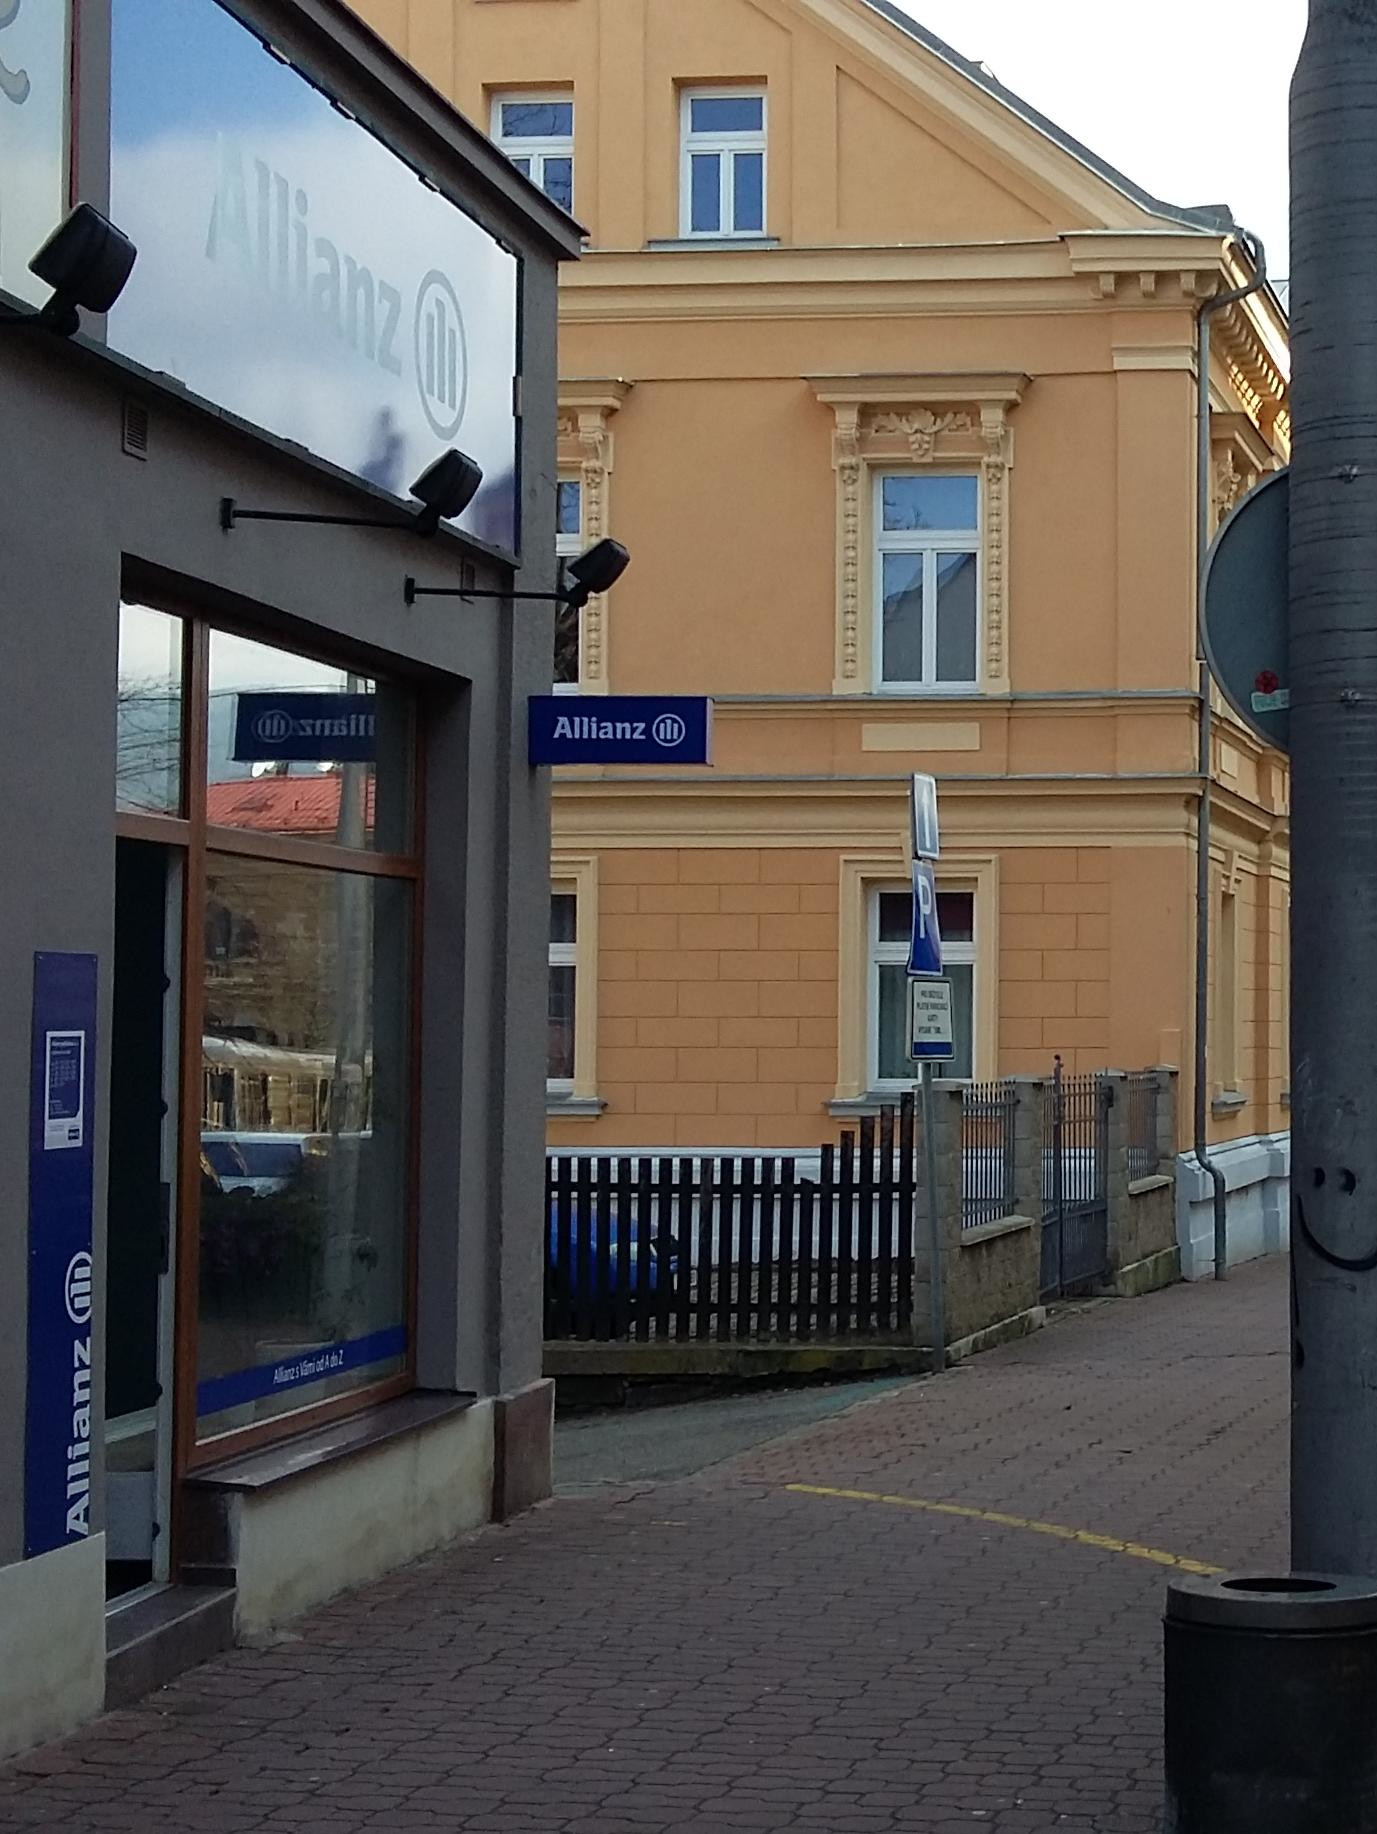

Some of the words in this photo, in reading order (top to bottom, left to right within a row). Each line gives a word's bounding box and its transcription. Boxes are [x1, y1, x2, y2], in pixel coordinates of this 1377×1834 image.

[204, 130, 403, 378] Allianz
[552, 716, 647, 740] Allianz
[917, 874, 932, 939] P
[272, 1365, 295, 1385] Allianz
[324, 1353, 330, 1369] A
[338, 1349, 344, 1366] Z
[66, 1336, 92, 1537] Allianz
